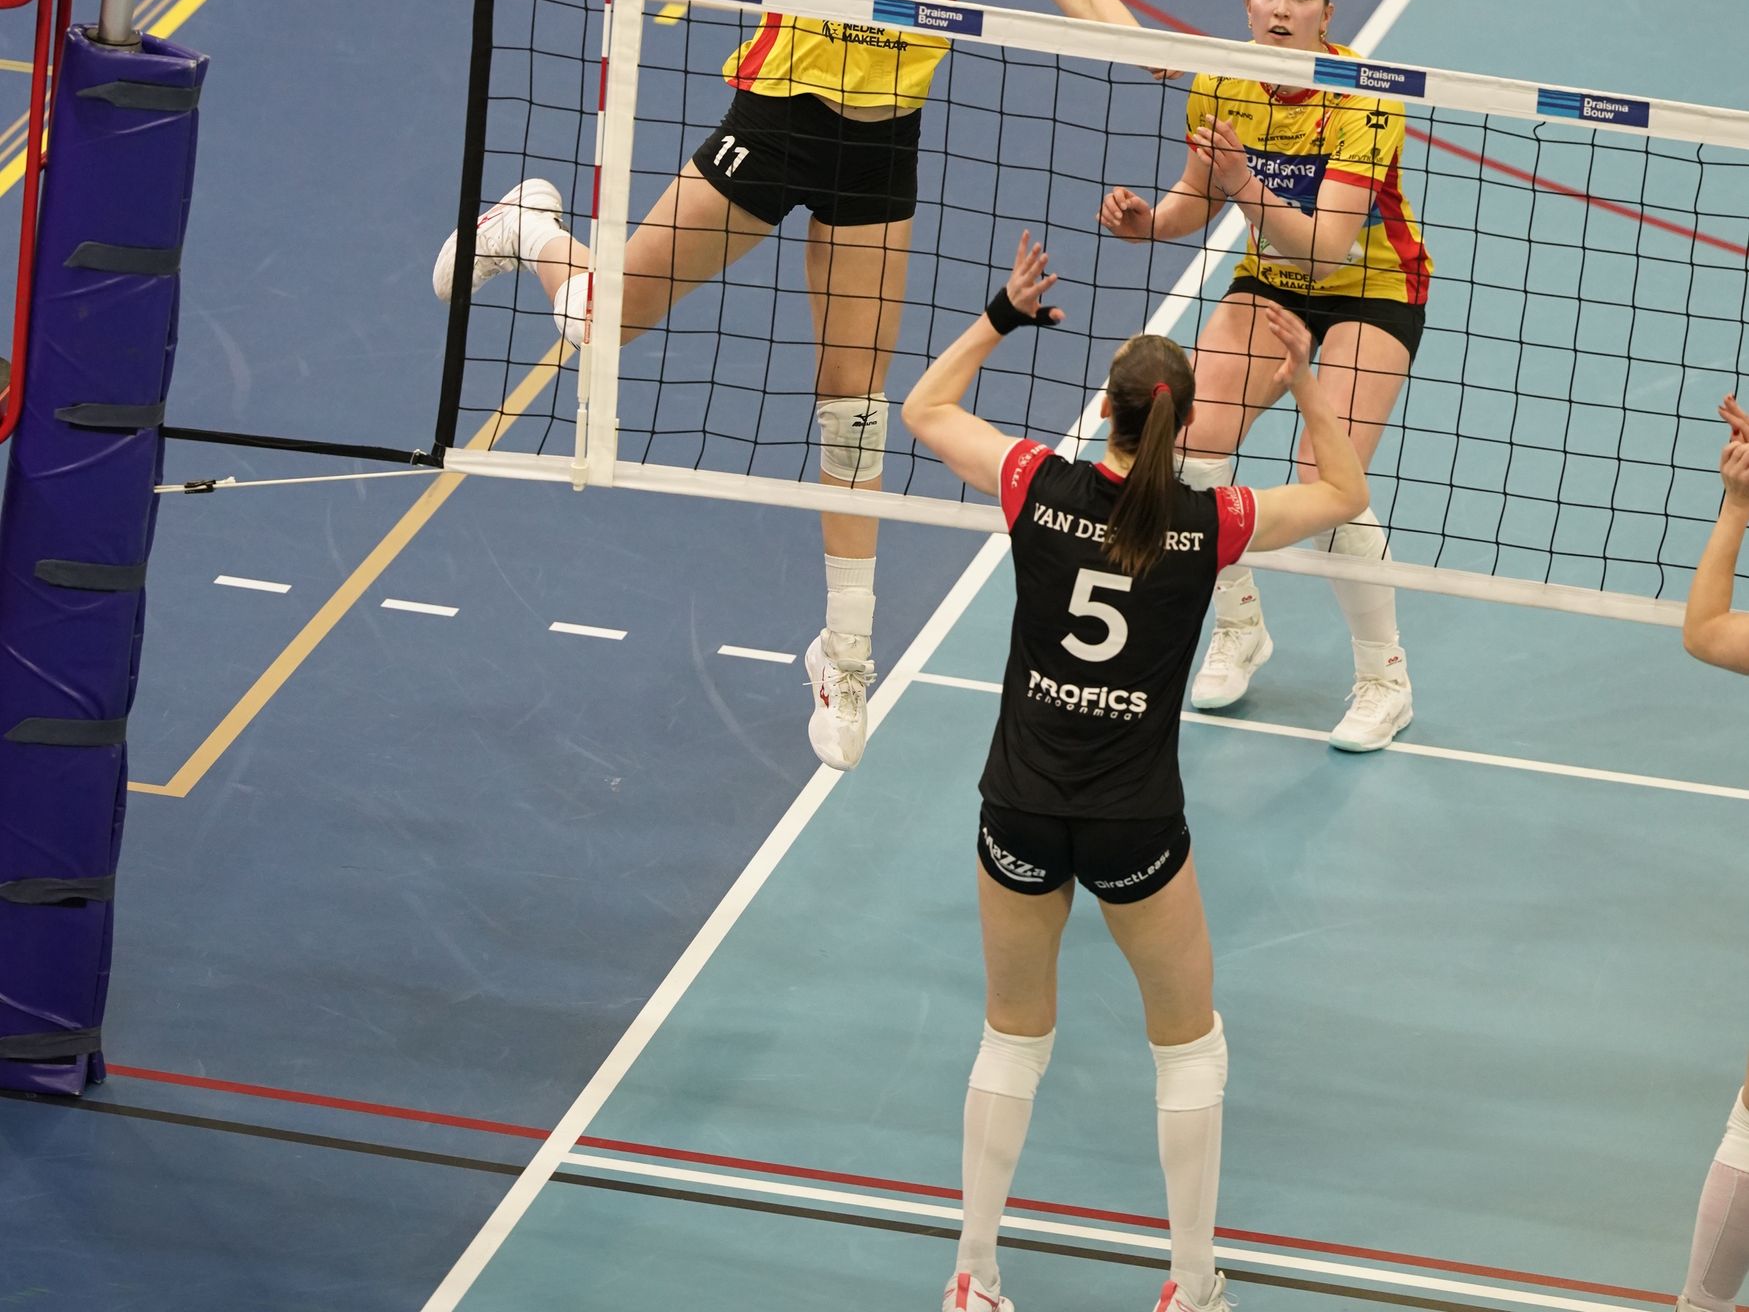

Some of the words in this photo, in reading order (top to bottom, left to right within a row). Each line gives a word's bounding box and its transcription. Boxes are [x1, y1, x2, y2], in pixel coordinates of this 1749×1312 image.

[917, 14, 949, 27] Bouw
[918, 5, 963, 21] Draisma
[841, 31, 908, 51] MAKELAAR
[1359, 76, 1390, 89] Bouw
[1360, 67, 1405, 82] Draisma
[1583, 98, 1629, 113] Draisma
[1583, 106, 1614, 120] Bouw
[713, 135, 751, 178] 11
[1033, 502, 1074, 533] VAN
[1075, 518, 1114, 544] DE
[1060, 568, 1133, 663] 5
[1027, 689, 1142, 721] schoonmaa
